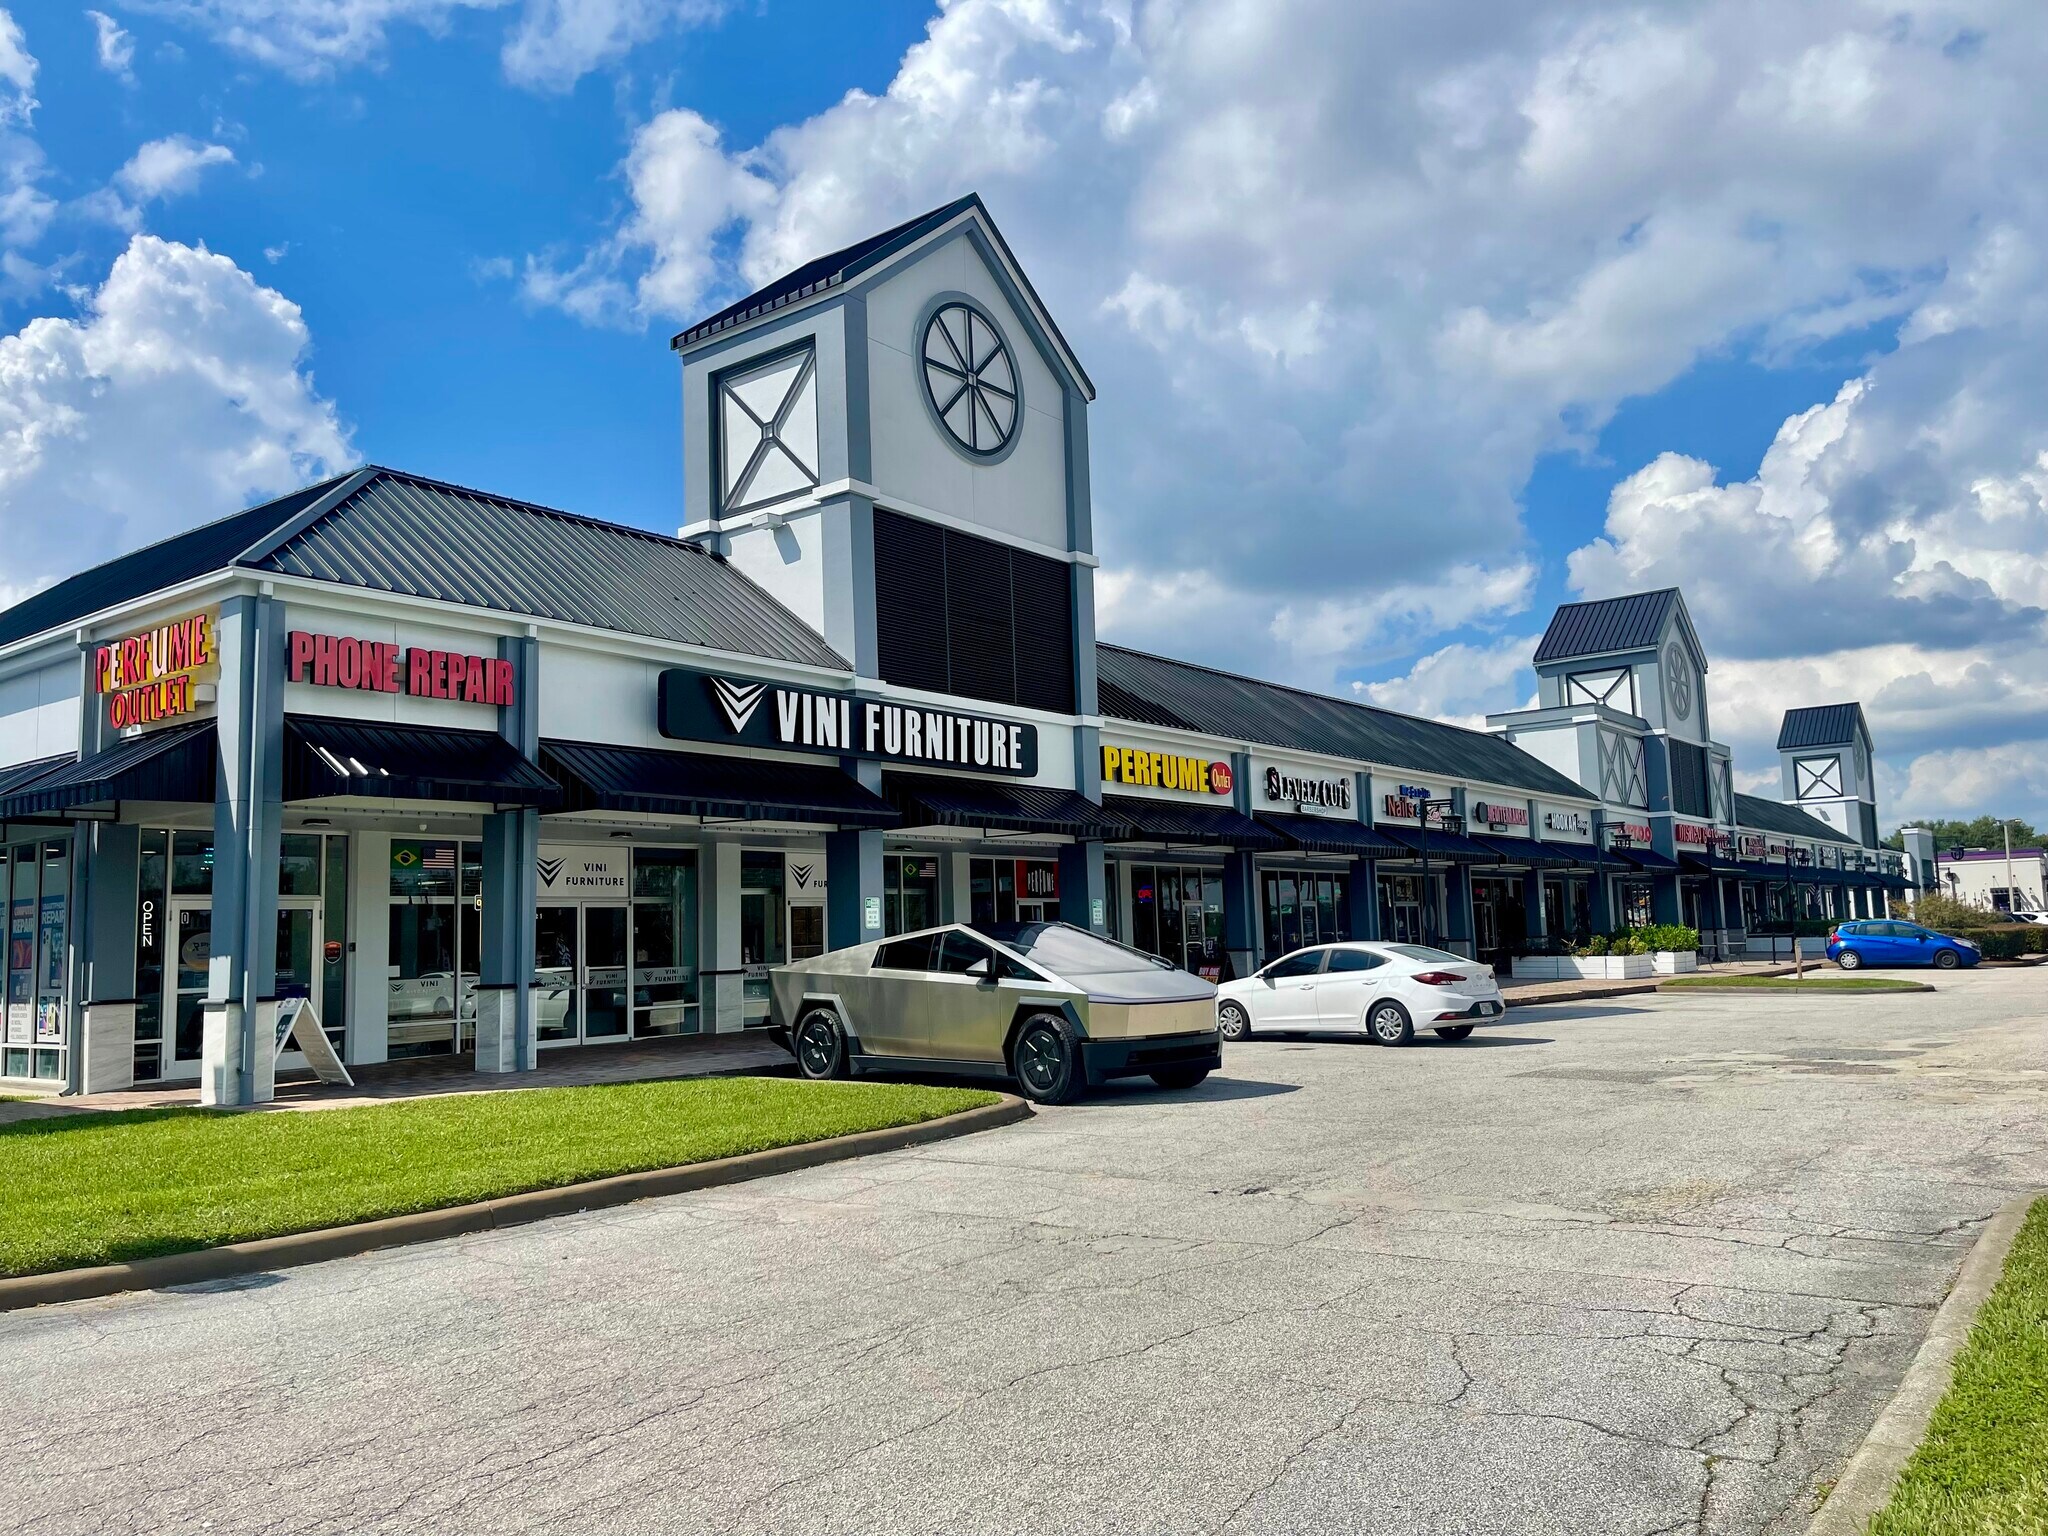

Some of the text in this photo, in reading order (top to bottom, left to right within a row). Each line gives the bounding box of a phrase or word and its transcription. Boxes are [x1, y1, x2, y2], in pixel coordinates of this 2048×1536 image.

[96, 614, 207, 694] PERFUME
[288, 631, 514, 706] PHONE REPAIR
[110, 675, 189, 729] OUTLET
[777, 690, 1022, 770] VINI FURNITURE
[1102, 745, 1210, 793] PERFUME
[1387, 795, 1414, 818] Nails
[1551, 813, 1577, 832] HOOKAH
[566, 877, 625, 886] FURNITURE
[584, 863, 607, 872] VINI
[142, 901, 154, 947] OPEN
[420, 980, 439, 988] VINI
